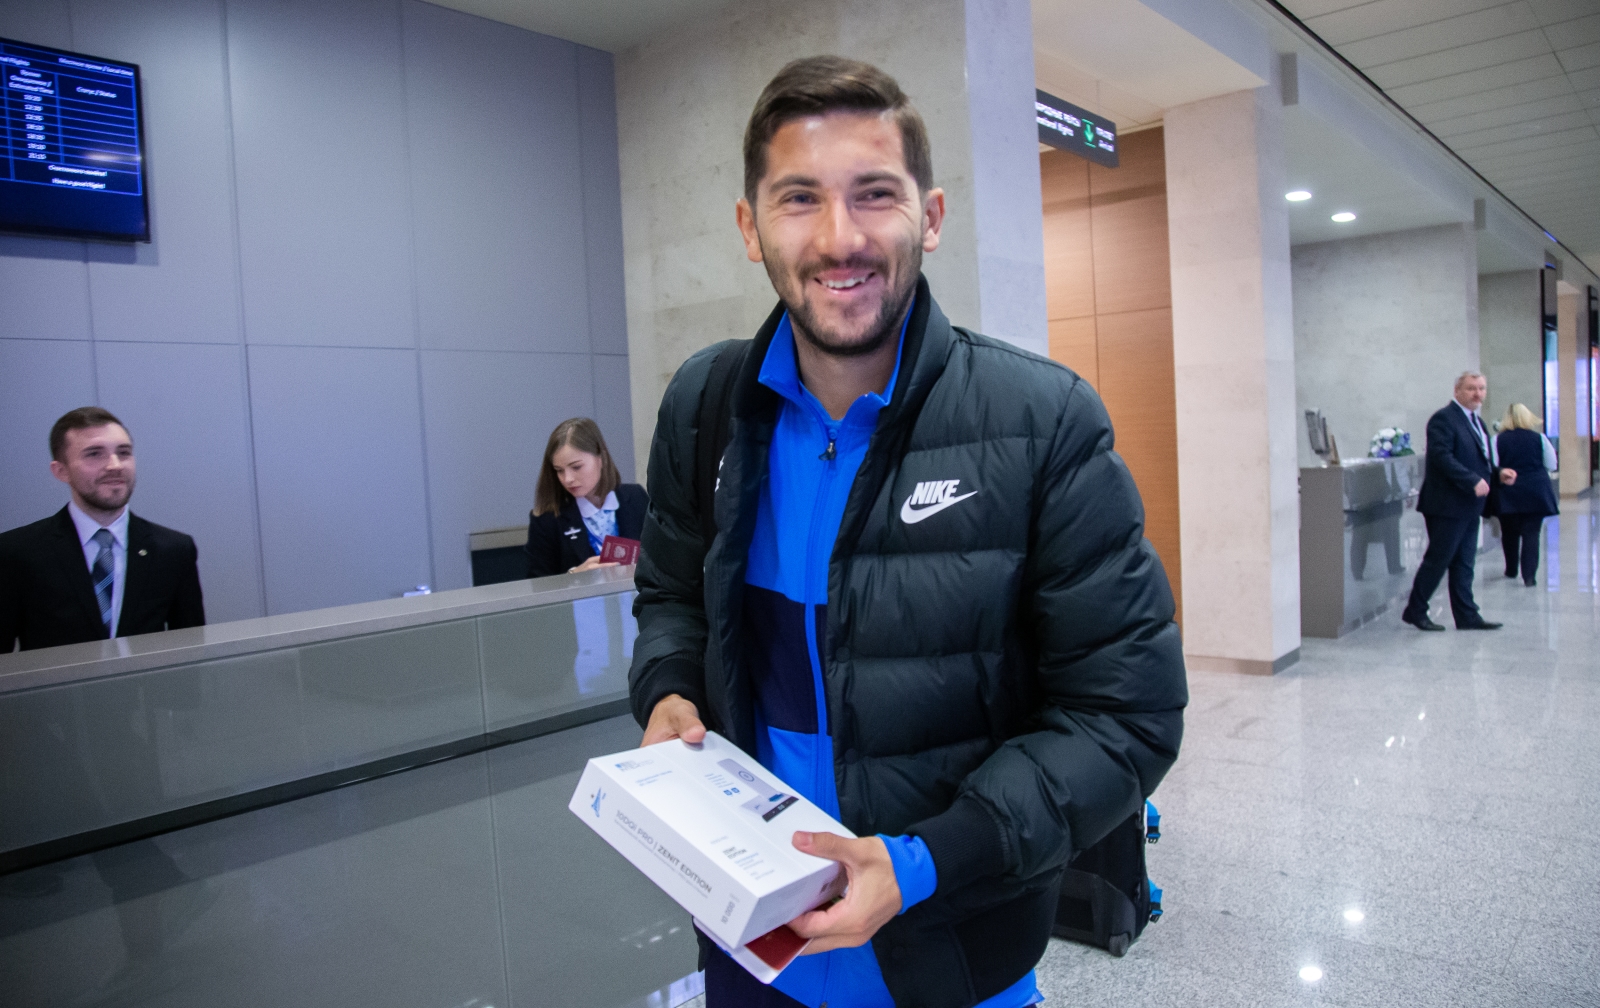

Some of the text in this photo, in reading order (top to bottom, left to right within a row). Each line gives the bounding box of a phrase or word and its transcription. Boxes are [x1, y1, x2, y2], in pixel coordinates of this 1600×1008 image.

[910, 479, 961, 506] NIKE
[657, 844, 681, 867] ZENIT
[679, 862, 713, 894] EDITION
